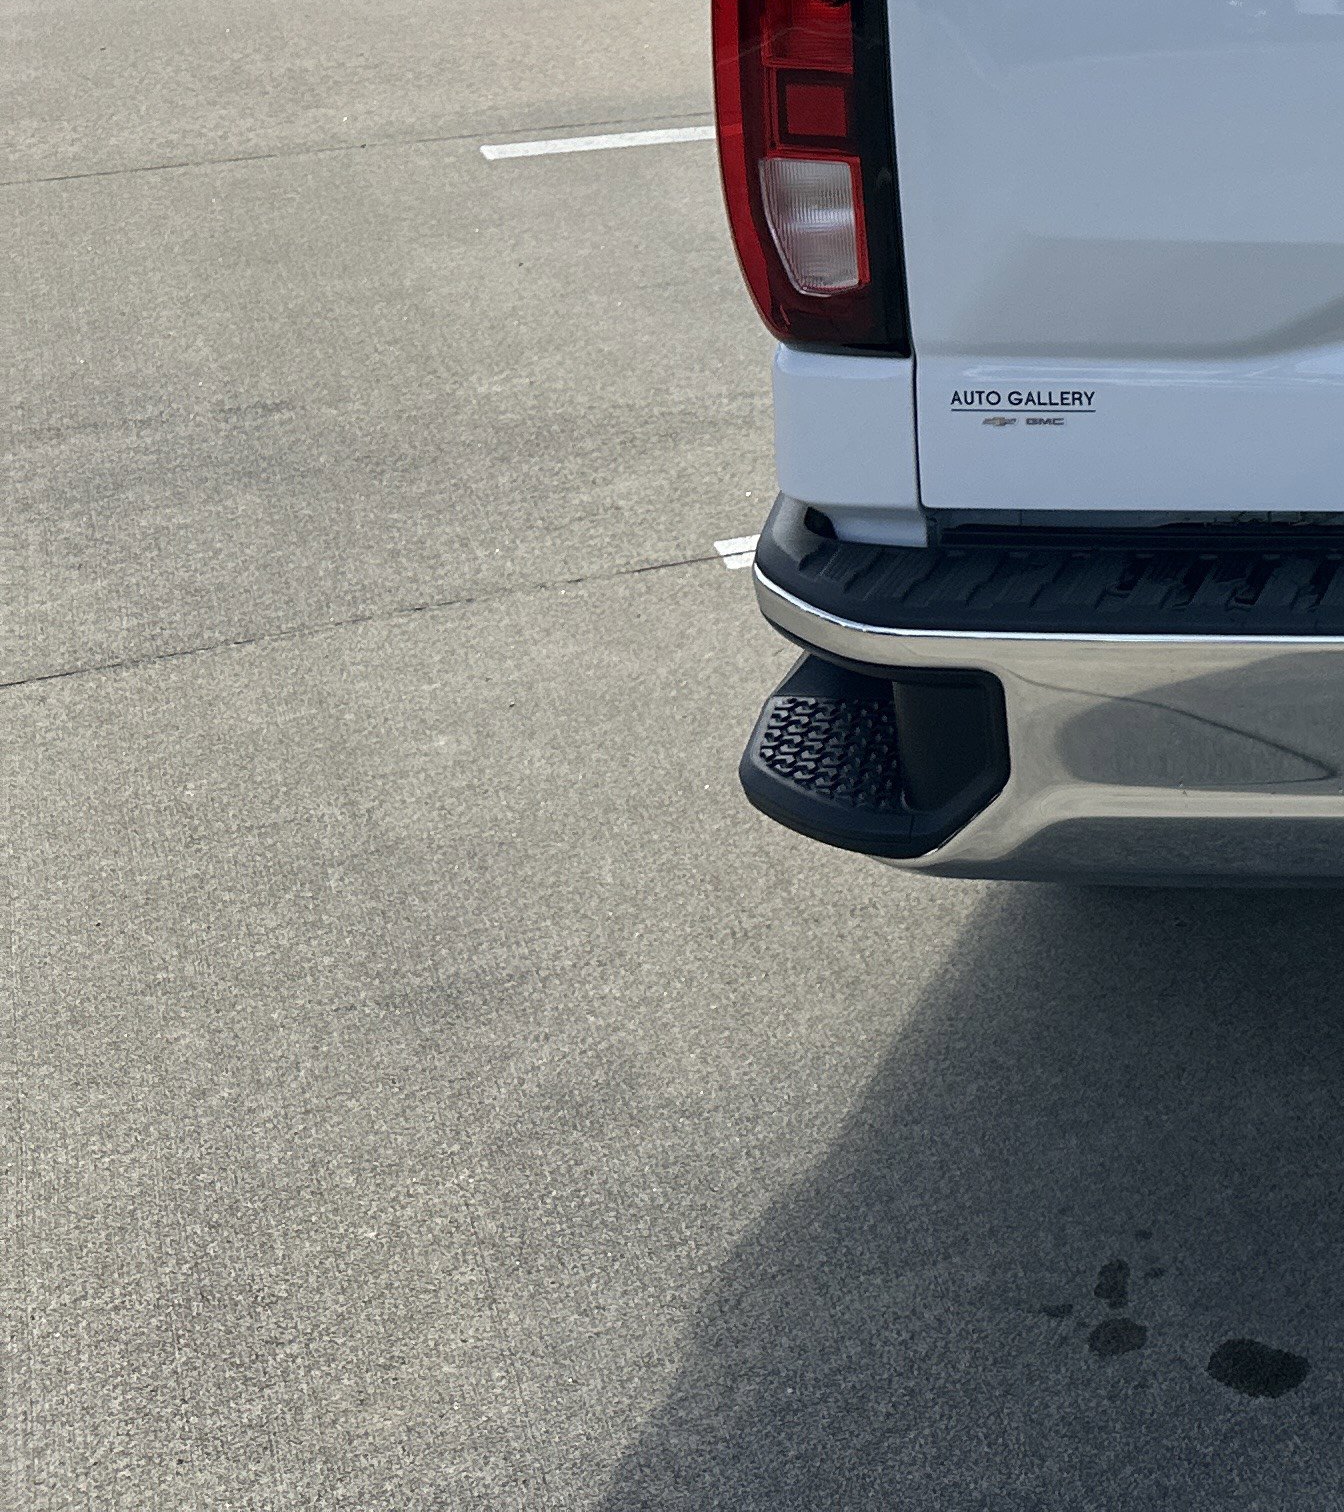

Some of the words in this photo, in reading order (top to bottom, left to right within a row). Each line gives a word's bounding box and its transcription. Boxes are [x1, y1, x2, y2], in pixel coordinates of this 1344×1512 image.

[951, 390, 1001, 405] AUTO
[1008, 391, 1095, 406] GALLERY
[1026, 417, 1064, 426] GMC
